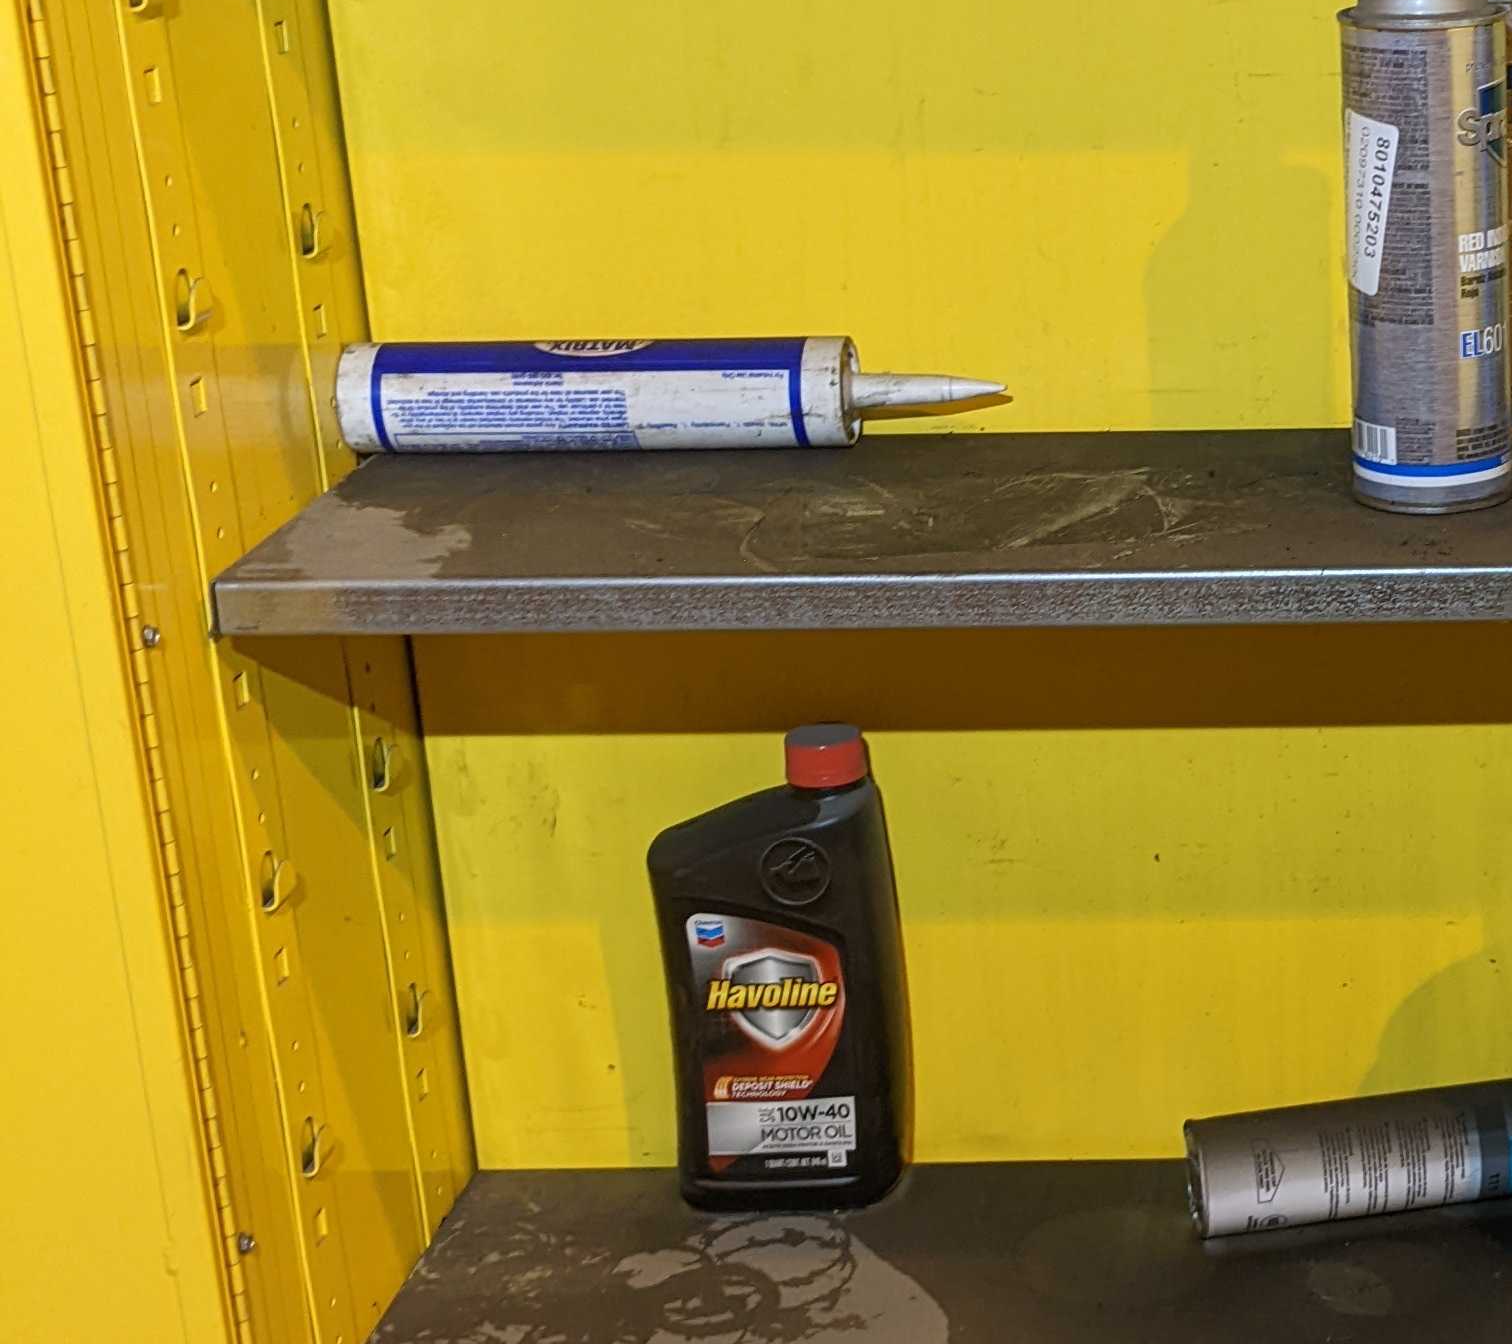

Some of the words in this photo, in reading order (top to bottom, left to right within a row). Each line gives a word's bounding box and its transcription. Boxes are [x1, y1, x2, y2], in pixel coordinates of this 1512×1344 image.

[705, 978, 839, 1010] Havoline
[731, 1080, 773, 1092] DEPOSIT
[777, 1103, 850, 1122] 10W-40
[761, 1126, 822, 1142] MOTOR
[824, 1124, 851, 1138] OIL
